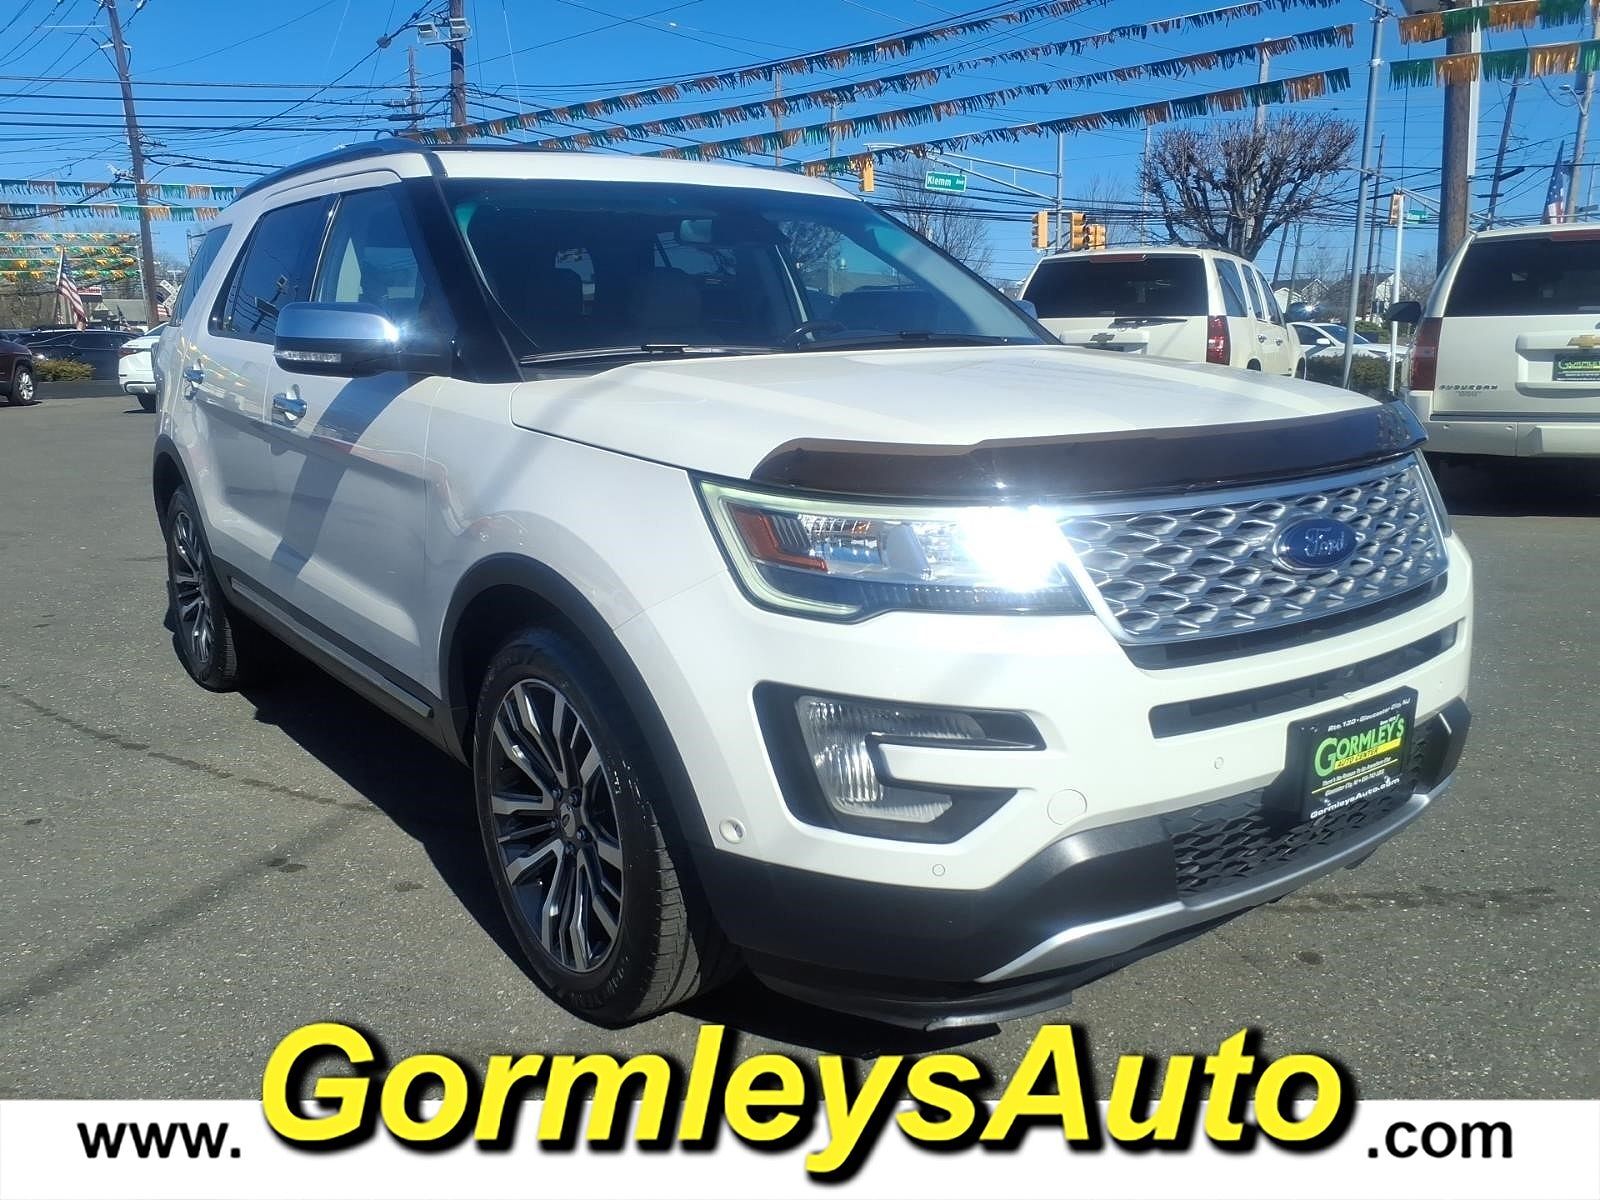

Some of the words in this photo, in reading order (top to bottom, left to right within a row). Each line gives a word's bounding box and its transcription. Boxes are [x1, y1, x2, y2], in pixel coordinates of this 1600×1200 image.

[928, 176, 951, 187] Klemm
[1304, 527, 1345, 557] Ford
[1314, 713, 1405, 777] GORMLEY'S
[1310, 778, 1400, 818] GormleysAuto.com
